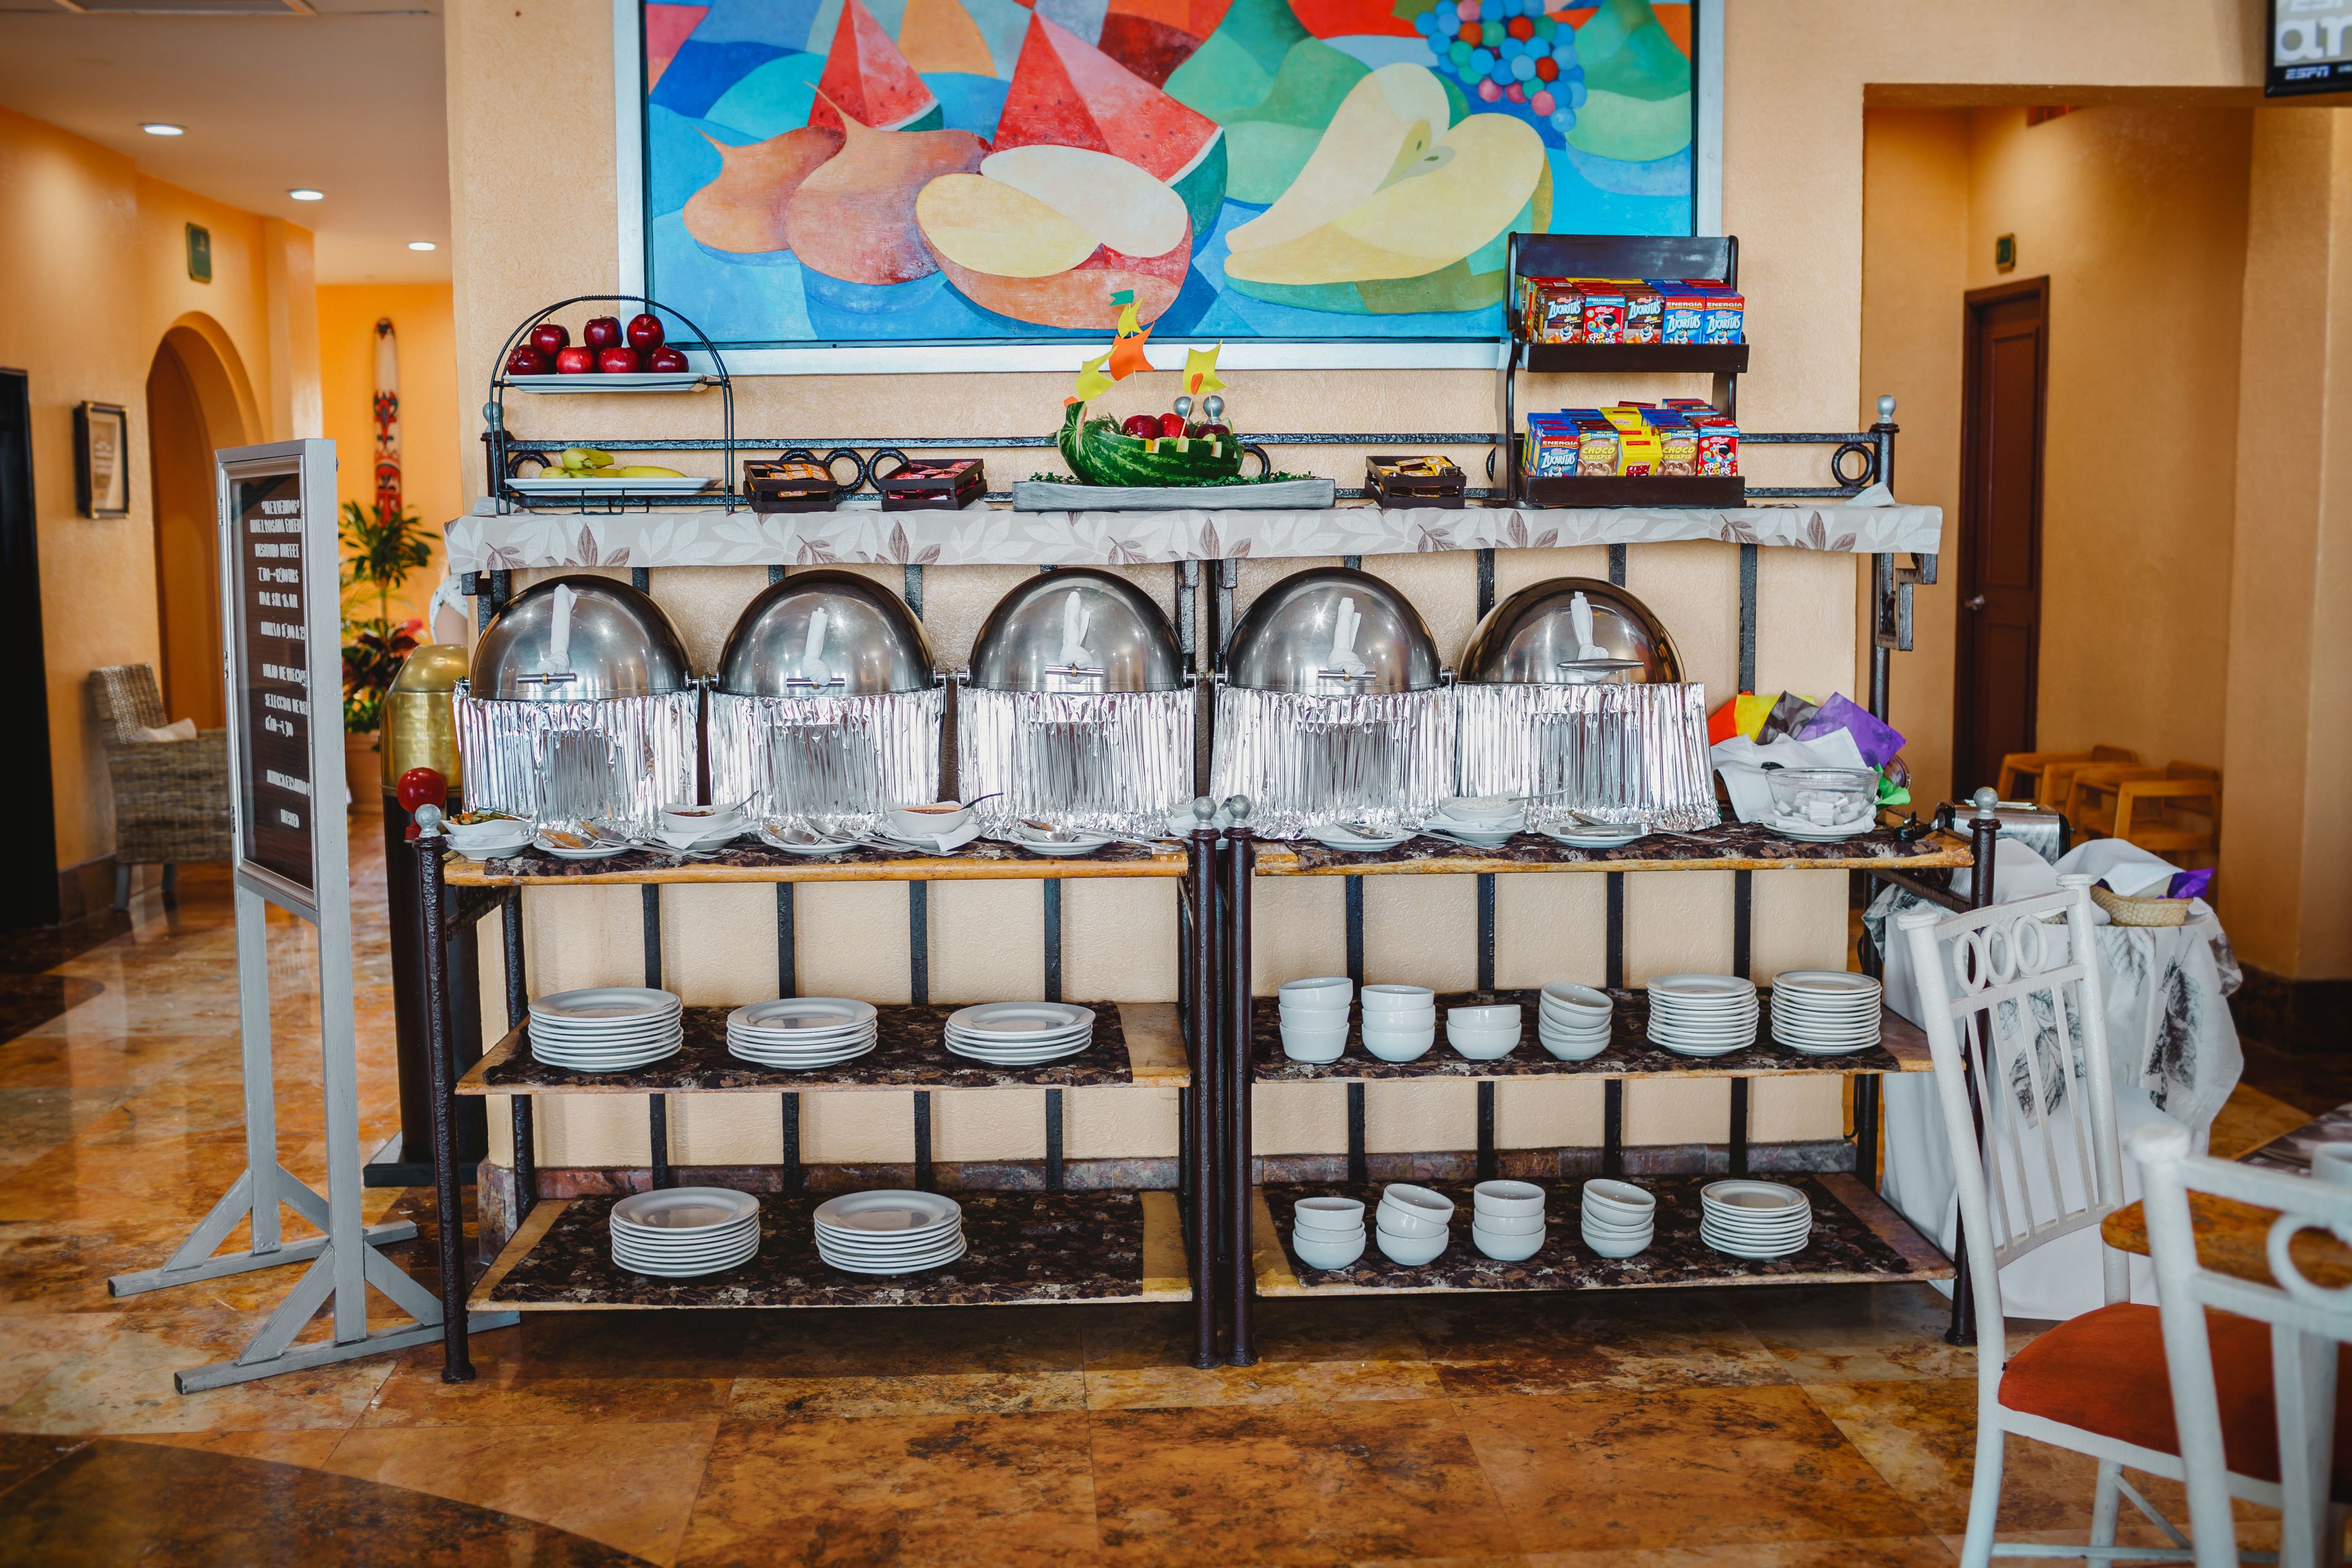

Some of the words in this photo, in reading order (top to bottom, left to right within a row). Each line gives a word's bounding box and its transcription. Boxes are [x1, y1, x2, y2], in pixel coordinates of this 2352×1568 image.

[2285, 64, 2330, 80] ESPN
[1547, 300, 1581, 320] ZUCARITAS
[1628, 300, 1661, 320] ZUCARITAS
[1666, 315, 1702, 334] ZUCARITAS
[1706, 315, 1741, 334] ZUCARITAS
[1588, 332, 1615, 341] FROOT
[1541, 451, 1576, 469] ZUCARITAS
[1703, 462, 1730, 471] FROOT
[279, 543, 300, 558] BUFFET
